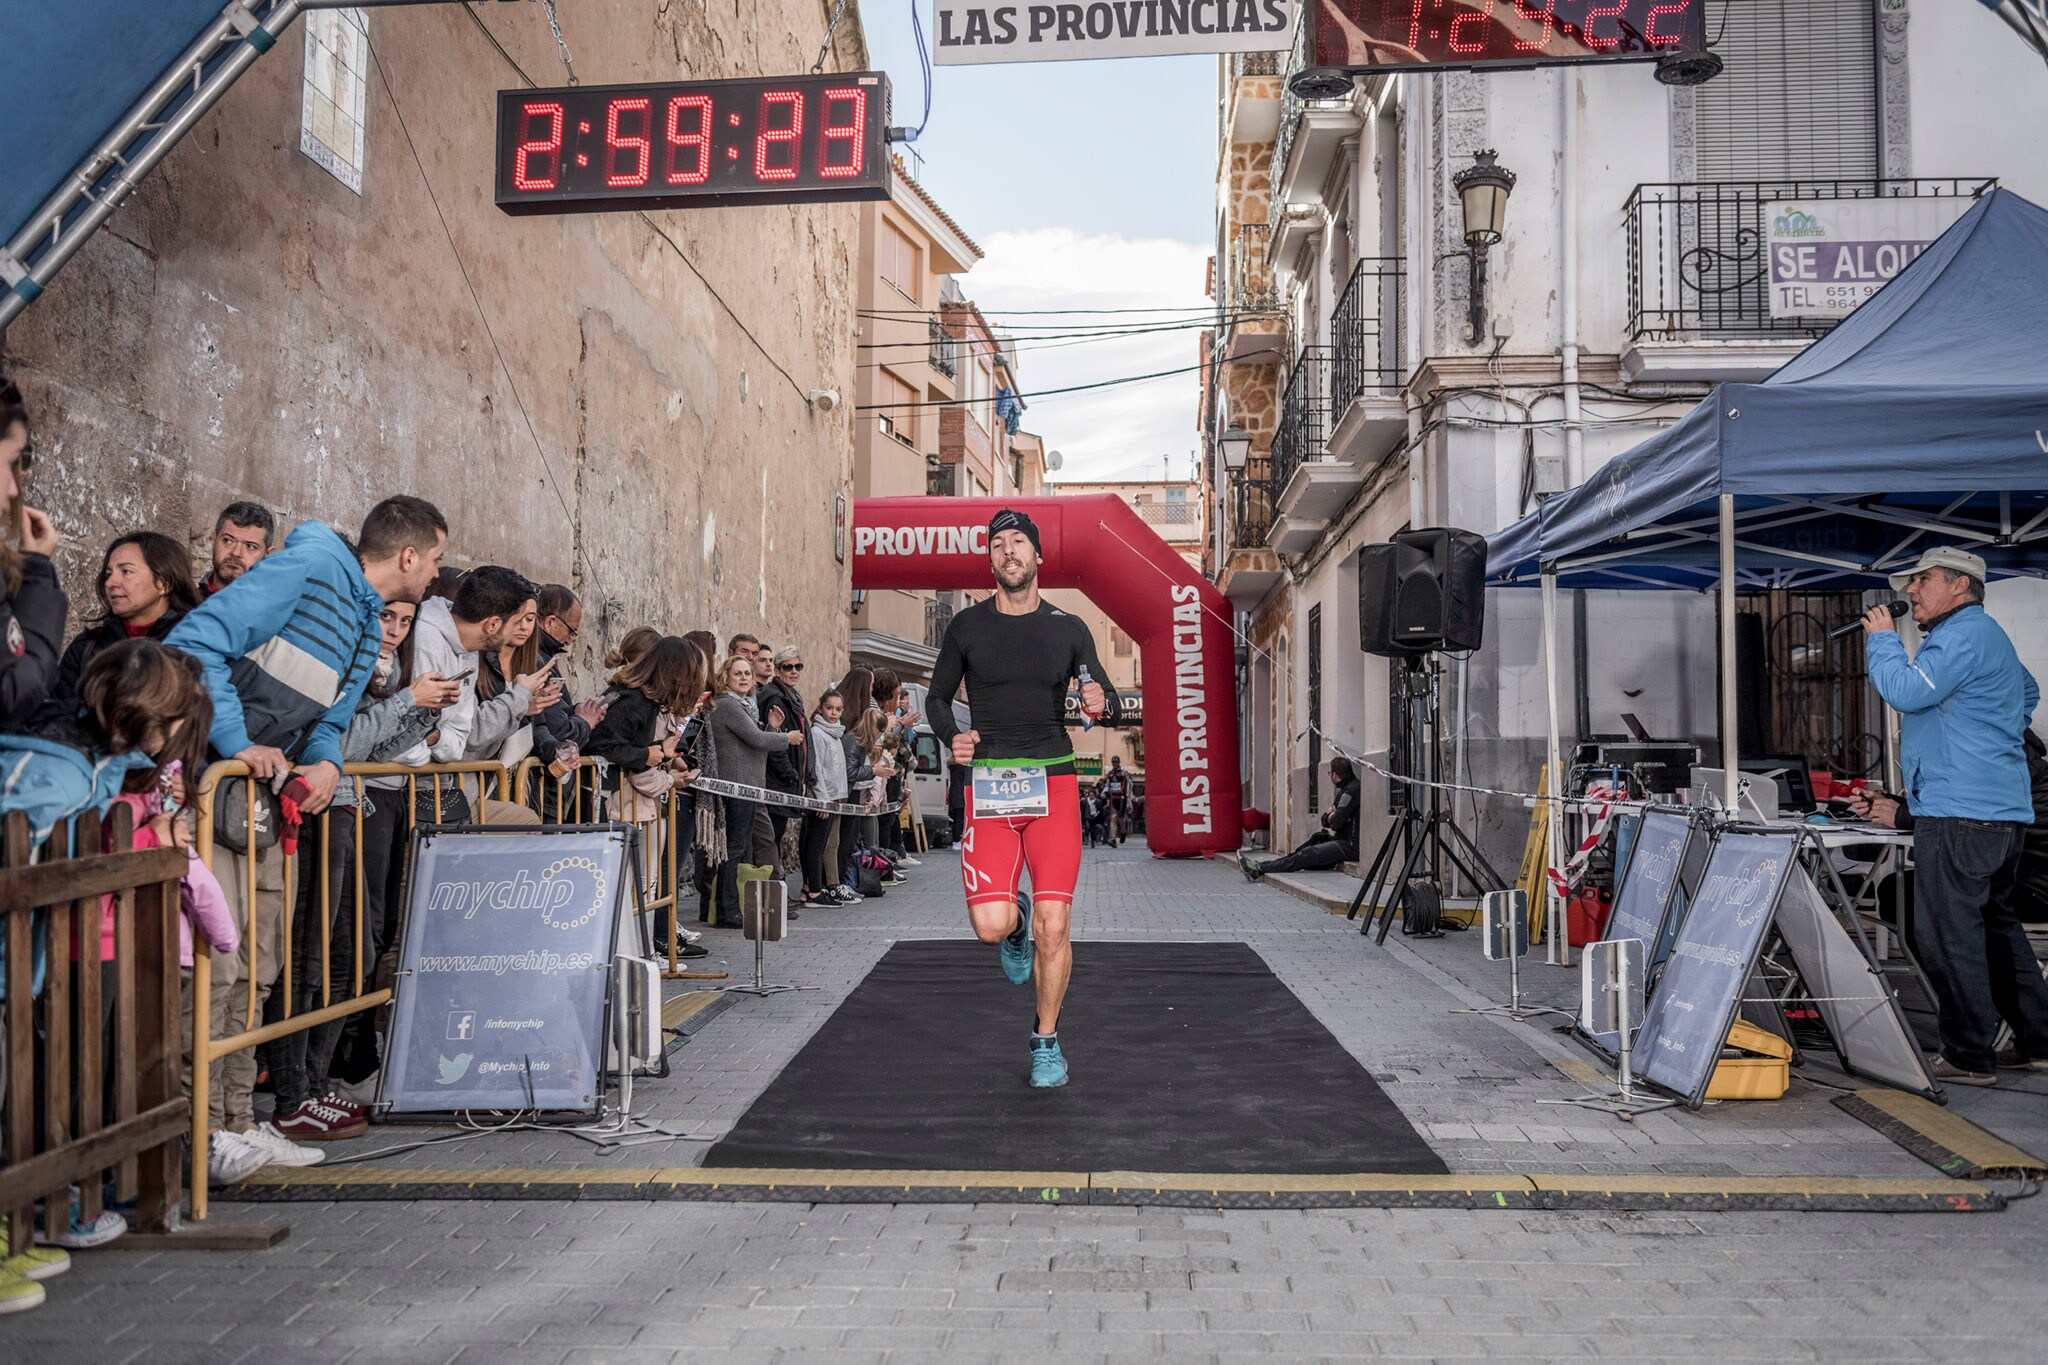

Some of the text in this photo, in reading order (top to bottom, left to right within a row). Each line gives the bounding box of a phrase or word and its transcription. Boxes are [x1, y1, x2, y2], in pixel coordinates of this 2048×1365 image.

[939, 0, 1288, 47] LAS PROVINCIAS
[514, 88, 867, 191] 2:59:23
[1778, 247, 1817, 279] SE
[1827, 286, 1856, 296] 651
[1864, 286, 1881, 297] 9
[1827, 299, 1857, 309] 964
[855, 525, 989, 556] PROVINC
[1171, 585, 1212, 834] LAS PROVINCIAS
[990, 780, 1031, 795] 1406
[429, 870, 575, 919] mychip
[1702, 868, 1760, 915] mychip
[420, 950, 593, 975] www.mychip.es
[484, 1018, 544, 1030] /infomychip
